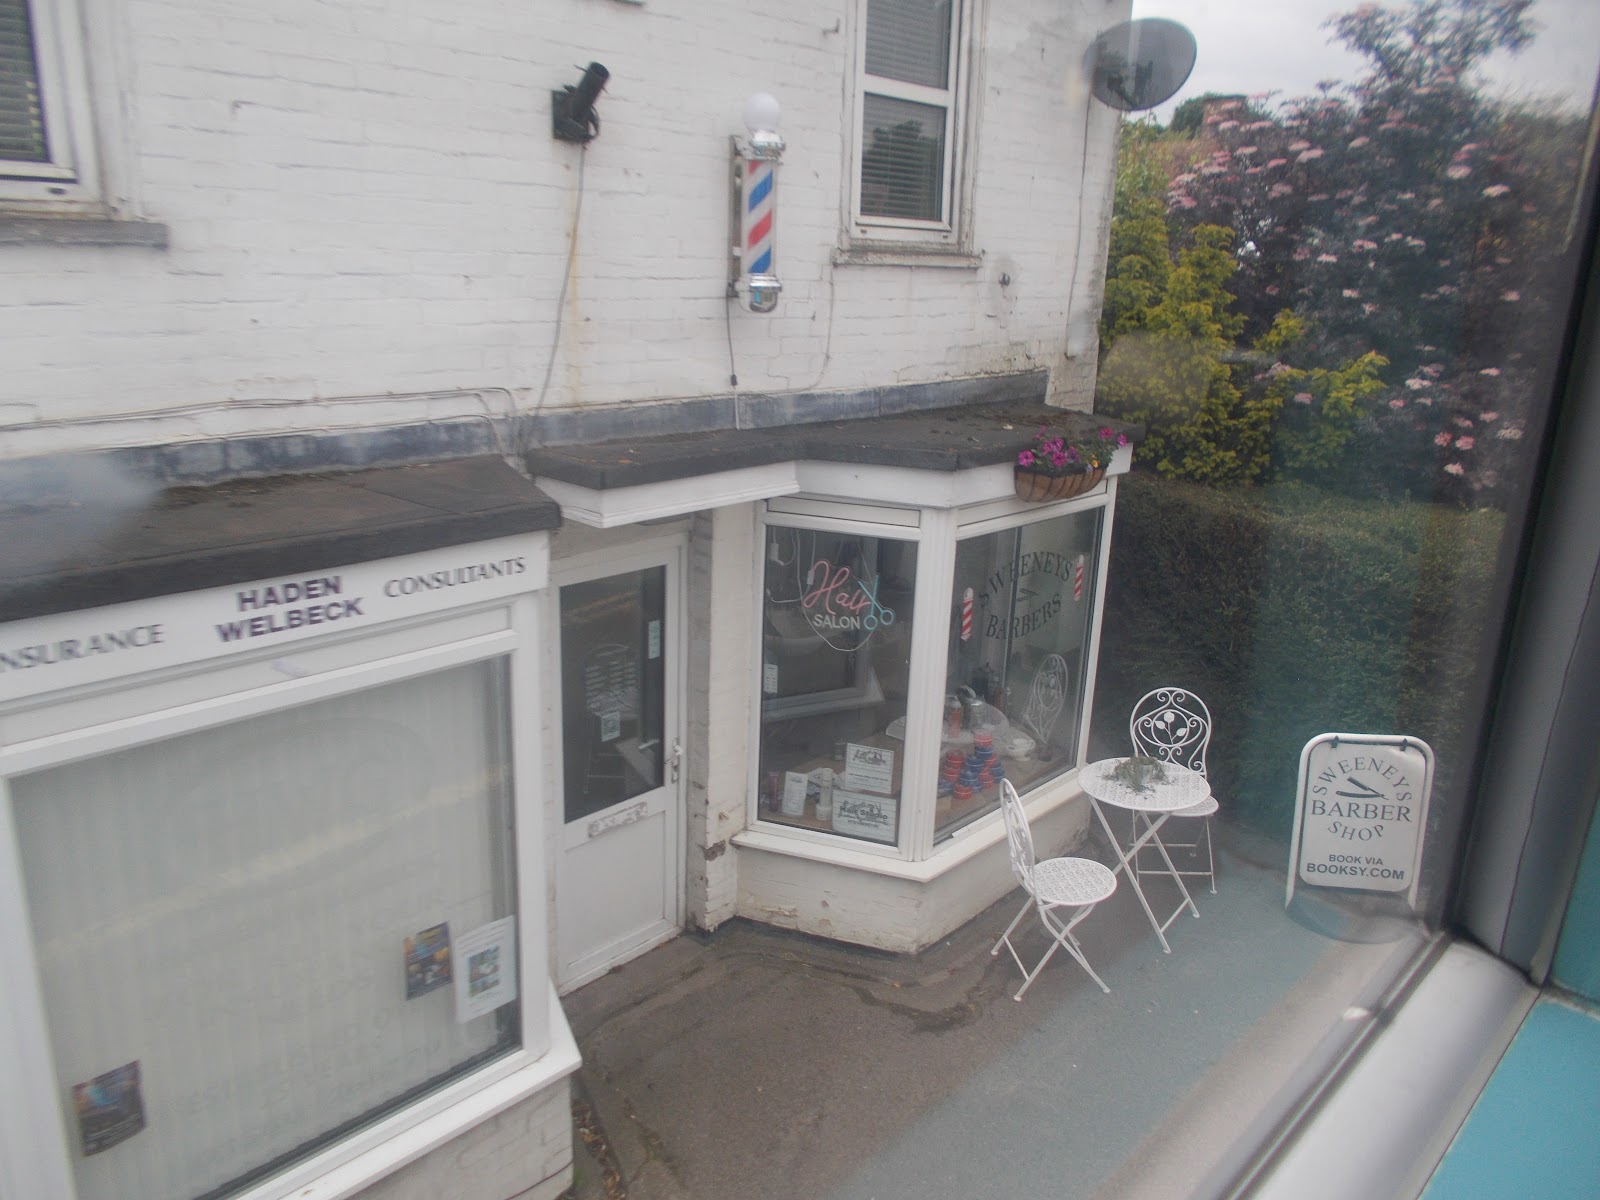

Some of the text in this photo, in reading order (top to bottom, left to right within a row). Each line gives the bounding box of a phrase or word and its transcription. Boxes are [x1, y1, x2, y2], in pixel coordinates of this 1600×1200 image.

[236, 576, 342, 612] HADEN
[384, 557, 526, 598] CONSULTANTS
[802, 560, 871, 615] Hair
[215, 597, 365, 642] WELBECK
[813, 613, 860, 630] SALON
[986, 593, 1062, 639] BARBERS
[1312, 756, 1412, 802] SWEENEYS
[1311, 800, 1412, 822] BARBER
[1328, 820, 1384, 841] SHOP
[1306, 863, 1404, 880] BOOKSY.COM
[1328, 854, 1384, 866] BOOK VIA
